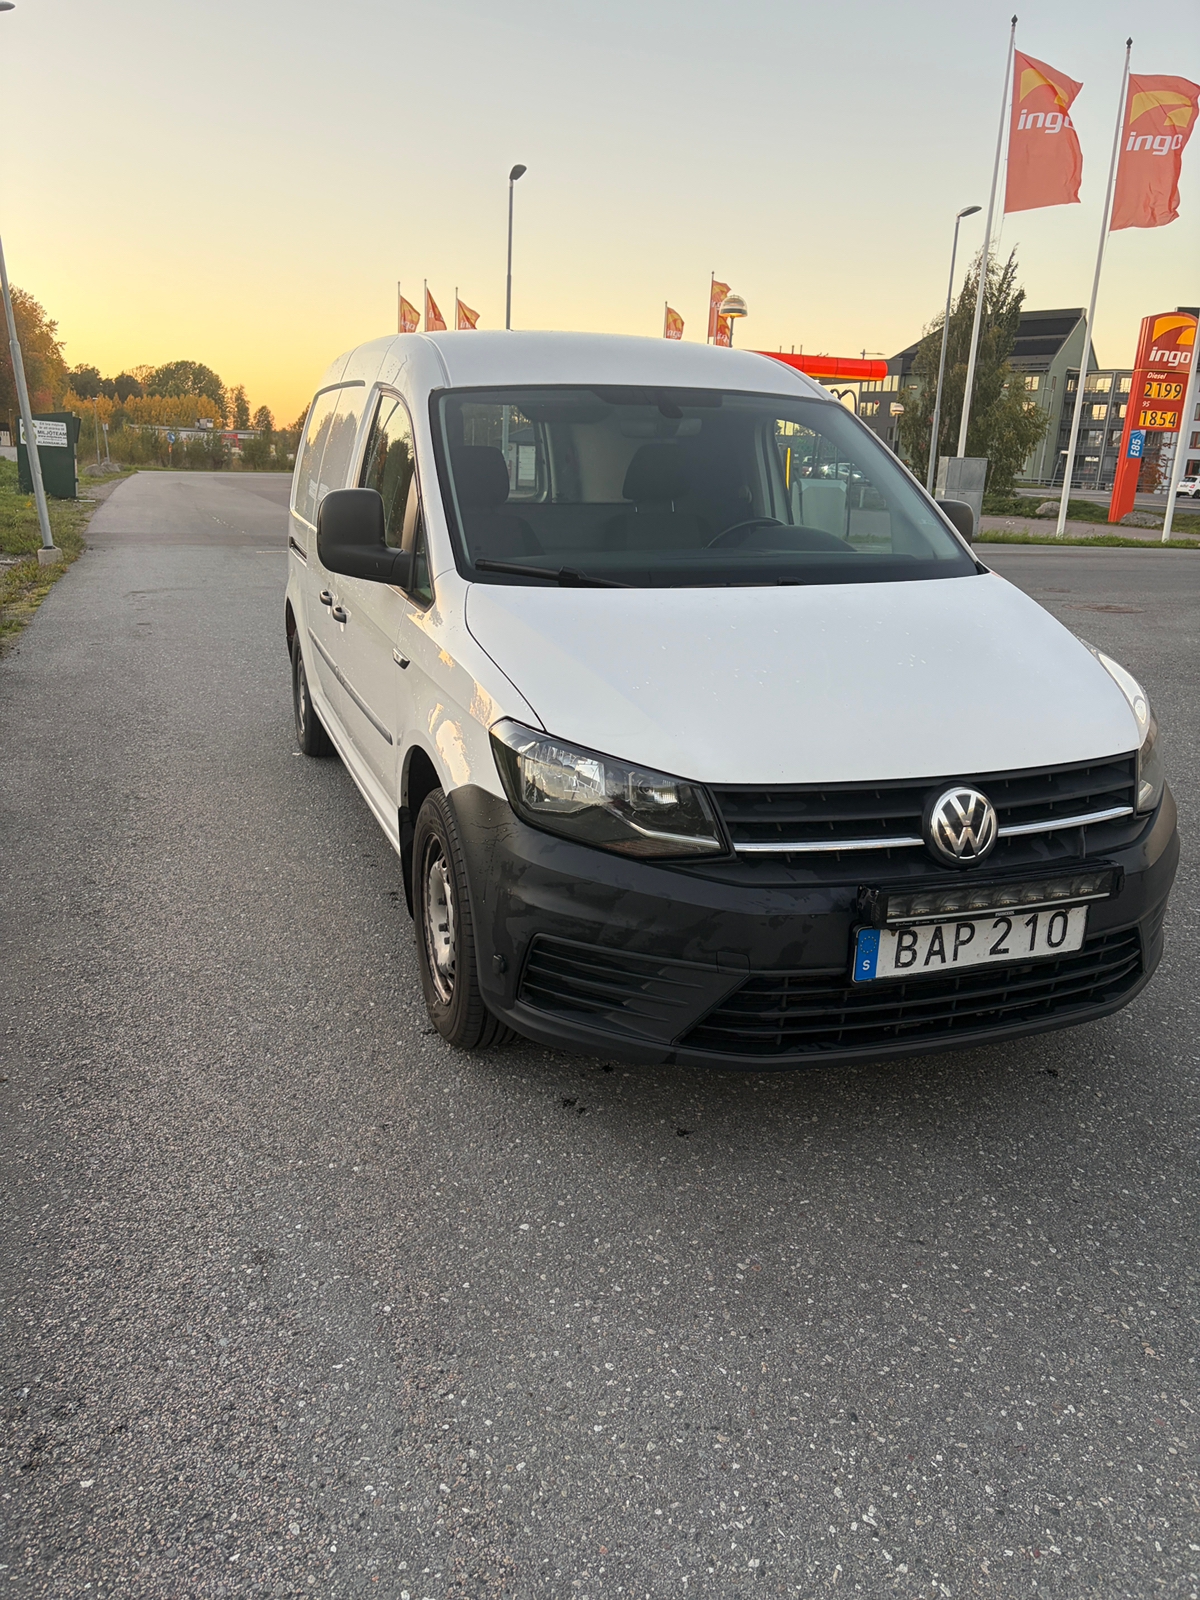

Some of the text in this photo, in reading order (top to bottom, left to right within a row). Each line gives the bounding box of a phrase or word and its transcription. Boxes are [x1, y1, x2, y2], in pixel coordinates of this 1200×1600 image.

[1149, 346, 1191, 367] ingo
[1147, 372, 1167, 380] Diesel
[1130, 438, 1141, 456] E85
[862, 911, 1070, 971] S BAP 210
